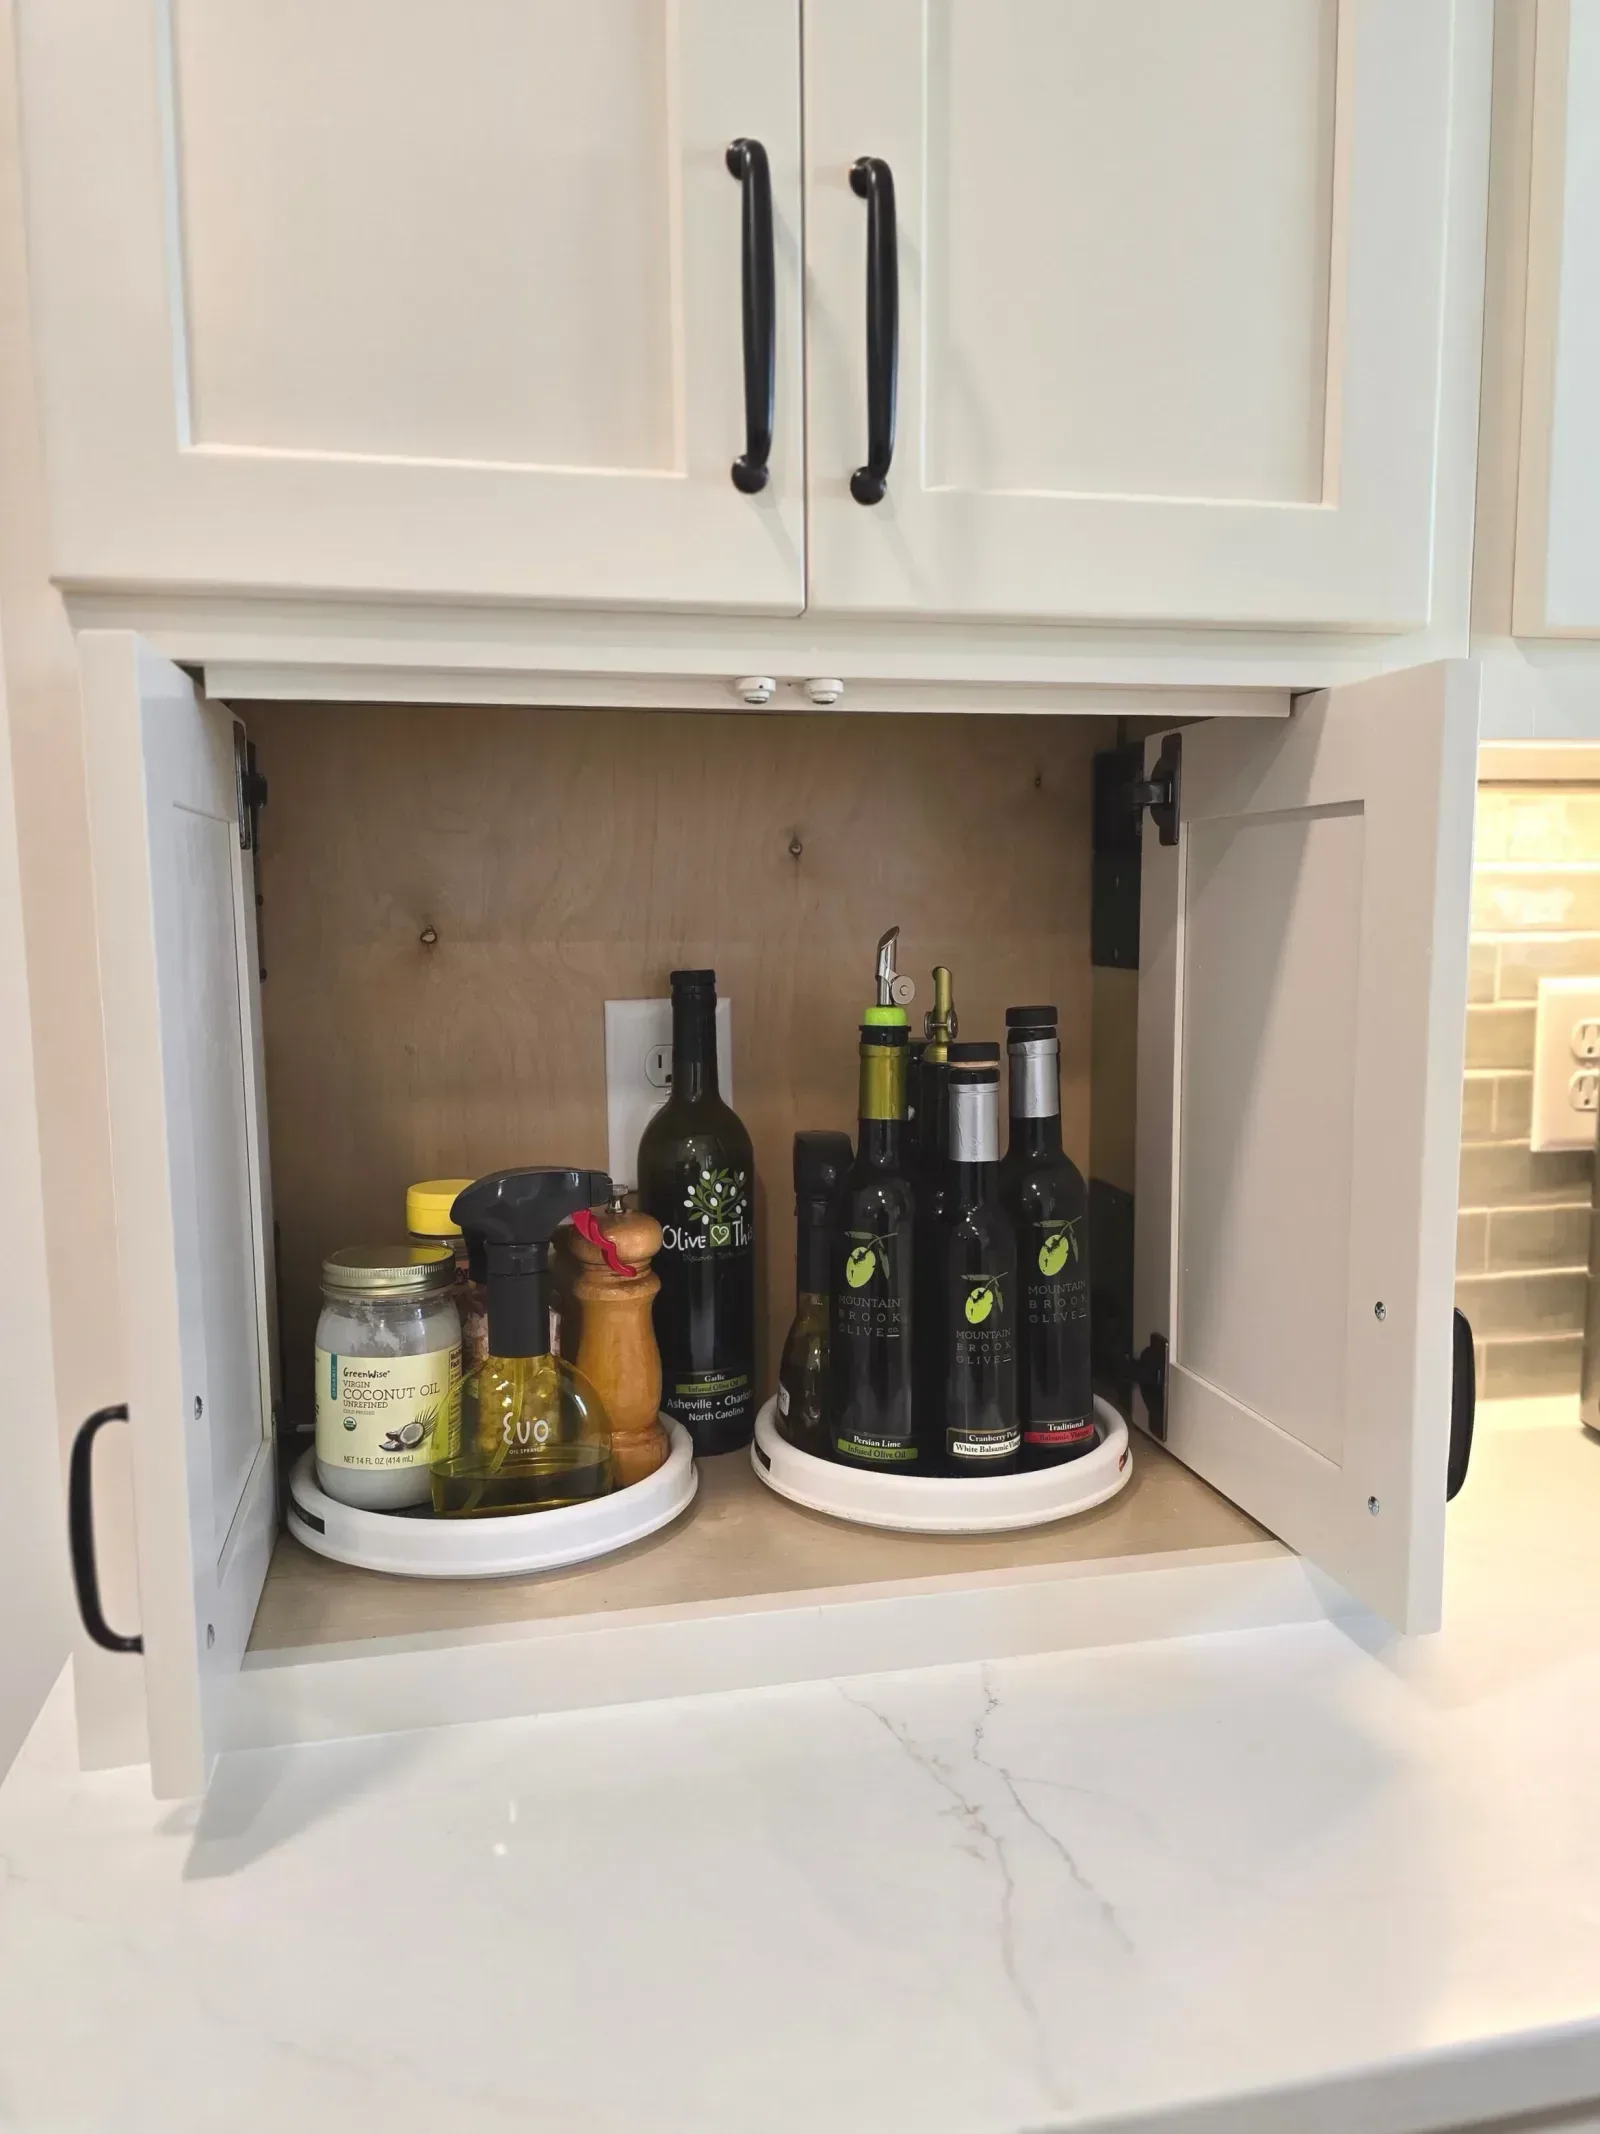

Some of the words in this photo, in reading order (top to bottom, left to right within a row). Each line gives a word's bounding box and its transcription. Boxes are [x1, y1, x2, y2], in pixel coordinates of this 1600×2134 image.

[662, 1224, 706, 1251] Olive
[1027, 1280, 1085, 1295] MOUNTAIN
[838, 1294, 901, 1308] MOUNTAIN
[838, 1307, 901, 1323] BROOK
[1028, 1310, 1078, 1323] OLIVE
[838, 1322, 885, 1337] OLIVE
[956, 1328, 1012, 1340] MOUNTAIN
[956, 1340, 1012, 1352] BROOK
[955, 1354, 1001, 1365] OLIVE
[343, 1380, 370, 1389] VIRGIN
[704, 1374, 725, 1383] Garlic
[343, 1387, 416, 1401] COCONUT
[420, 1382, 441, 1397] OIL
[688, 1384, 711, 1393] Infused
[712, 1382, 730, 1391] Olive
[343, 1400, 388, 1409] UNREFINED
[666, 1398, 712, 1410] Asheville
[688, 1412, 714, 1422] North
[715, 1407, 745, 1420] Carolina
[1047, 1419, 1084, 1431] Traditional
[853, 1435, 880, 1447] Persian
[881, 1439, 901, 1448] Lime
[968, 1434, 1006, 1443] Cranberry
[847, 1444, 872, 1457] Infused
[873, 1449, 893, 1459] Olive
[894, 1450, 906, 1459] Oil
[955, 1443, 978, 1453] White
[979, 1444, 1009, 1453] Balsamic
[343, 1456, 355, 1464] NET
[356, 1456, 364, 1464] 14
[365, 1457, 373, 1465] FL
[374, 1457, 384, 1465] OZ
[385, 1456, 401, 1465] (414
[401, 1454, 414, 1464] mL)
